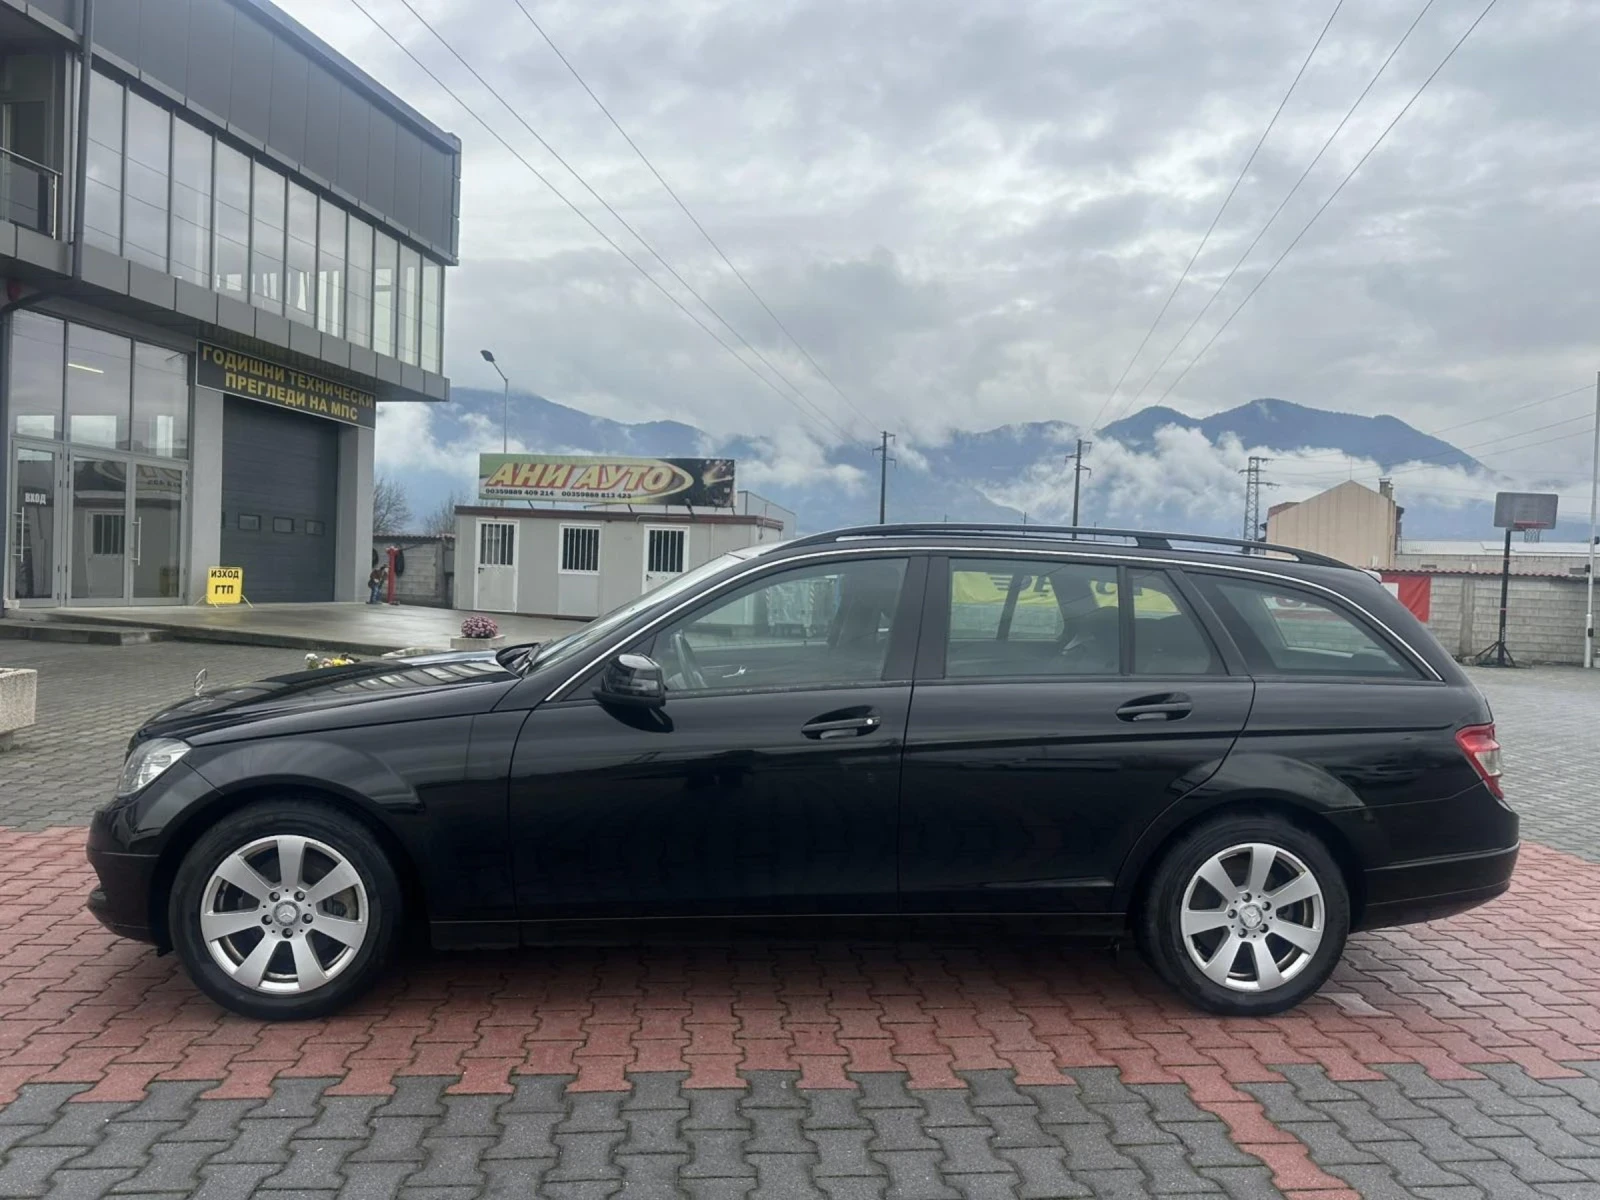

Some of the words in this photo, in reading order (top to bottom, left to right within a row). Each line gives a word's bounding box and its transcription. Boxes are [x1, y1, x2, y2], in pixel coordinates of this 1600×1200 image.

[203, 346, 285, 382] ГОДИШНИ
[289, 371, 374, 408] ТЕХНИЧЕСКИ
[225, 373, 305, 406] ПРЕГЛЕДИ
[309, 395, 328, 411] НА
[331, 402, 358, 420] МПС
[486, 463, 570, 489] АНИ
[573, 464, 676, 492] АУТО
[25, 492, 46, 504] ВХОД
[210, 569, 239, 580] ИЗХОД
[214, 585, 233, 594] ГТП
